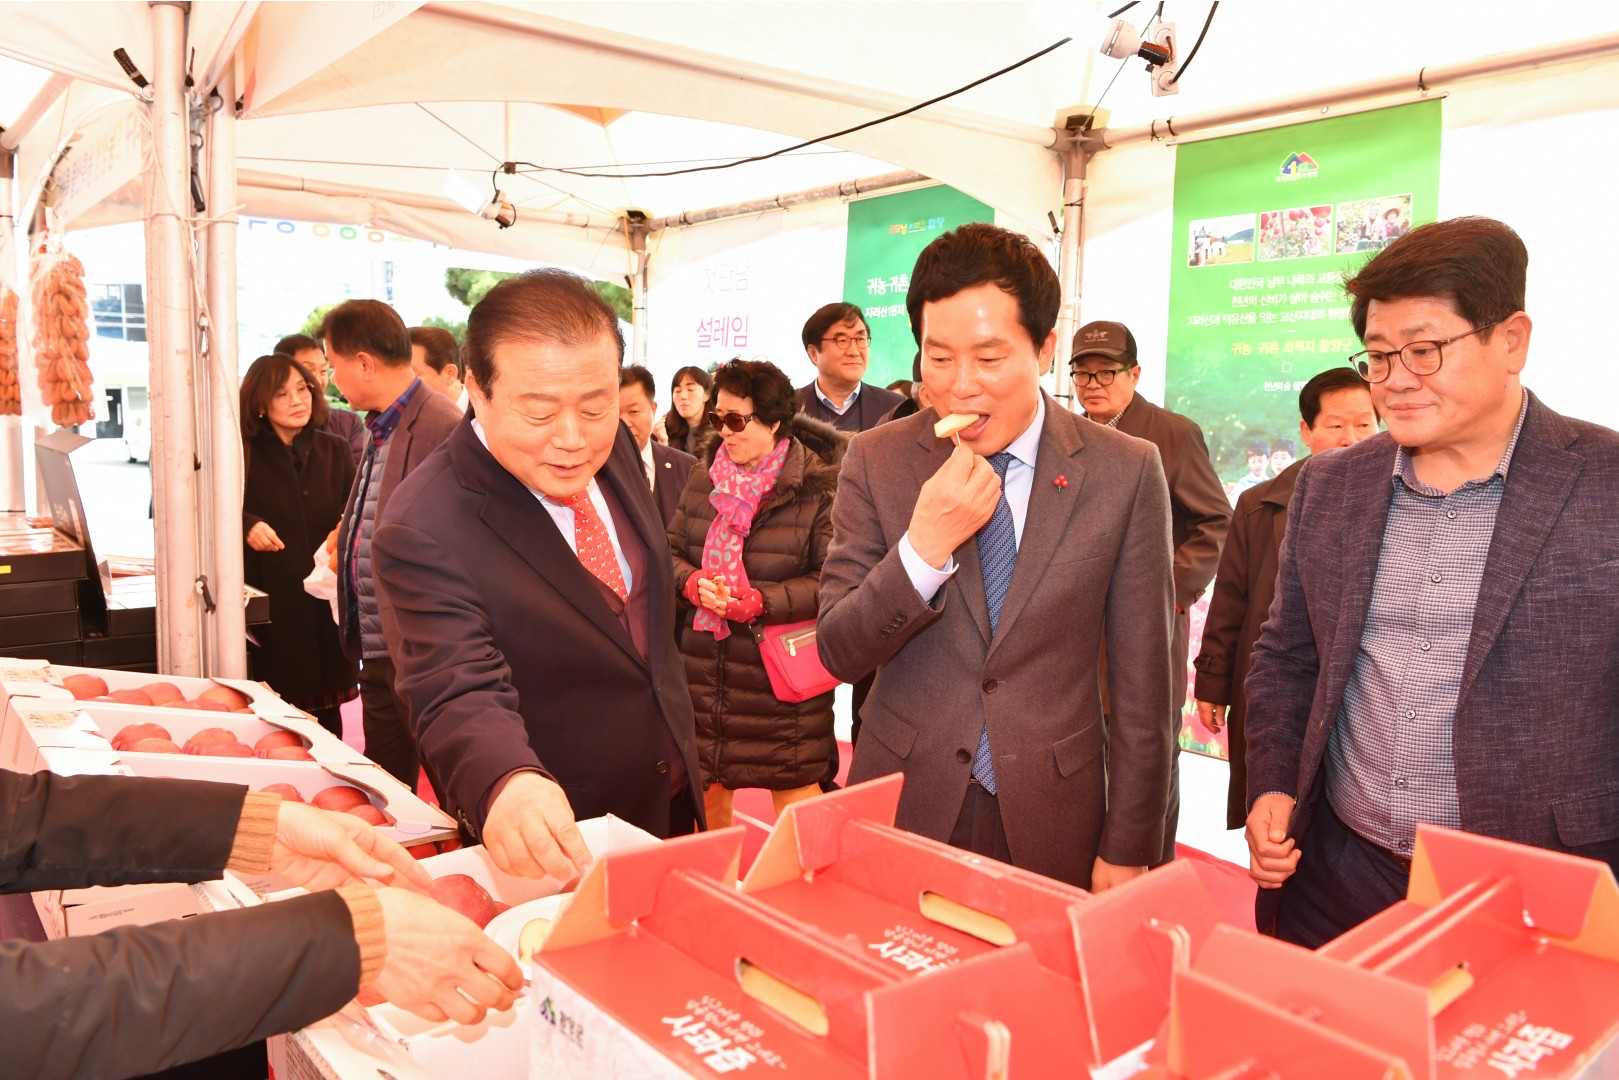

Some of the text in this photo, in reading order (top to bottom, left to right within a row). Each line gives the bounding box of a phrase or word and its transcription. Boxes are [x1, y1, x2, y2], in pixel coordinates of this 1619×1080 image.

[1229, 277, 1264, 291] 대한민국
[1267, 275, 1285, 289] 남부
[1231, 295, 1258, 308] 천년의
[1259, 293, 1287, 307] 신비가
[1310, 290, 1338, 304] 숨쉬는
[1187, 314, 1221, 328] 지리산과
[1222, 312, 1257, 326] 덕유산을
[696, 314, 749, 348] 설레임
[1283, 339, 1316, 355] 최적지
[1319, 338, 1353, 353] 함양군
[661, 1013, 759, 1074] 사과즙
[1486, 1023, 1576, 1079] 사과즙
